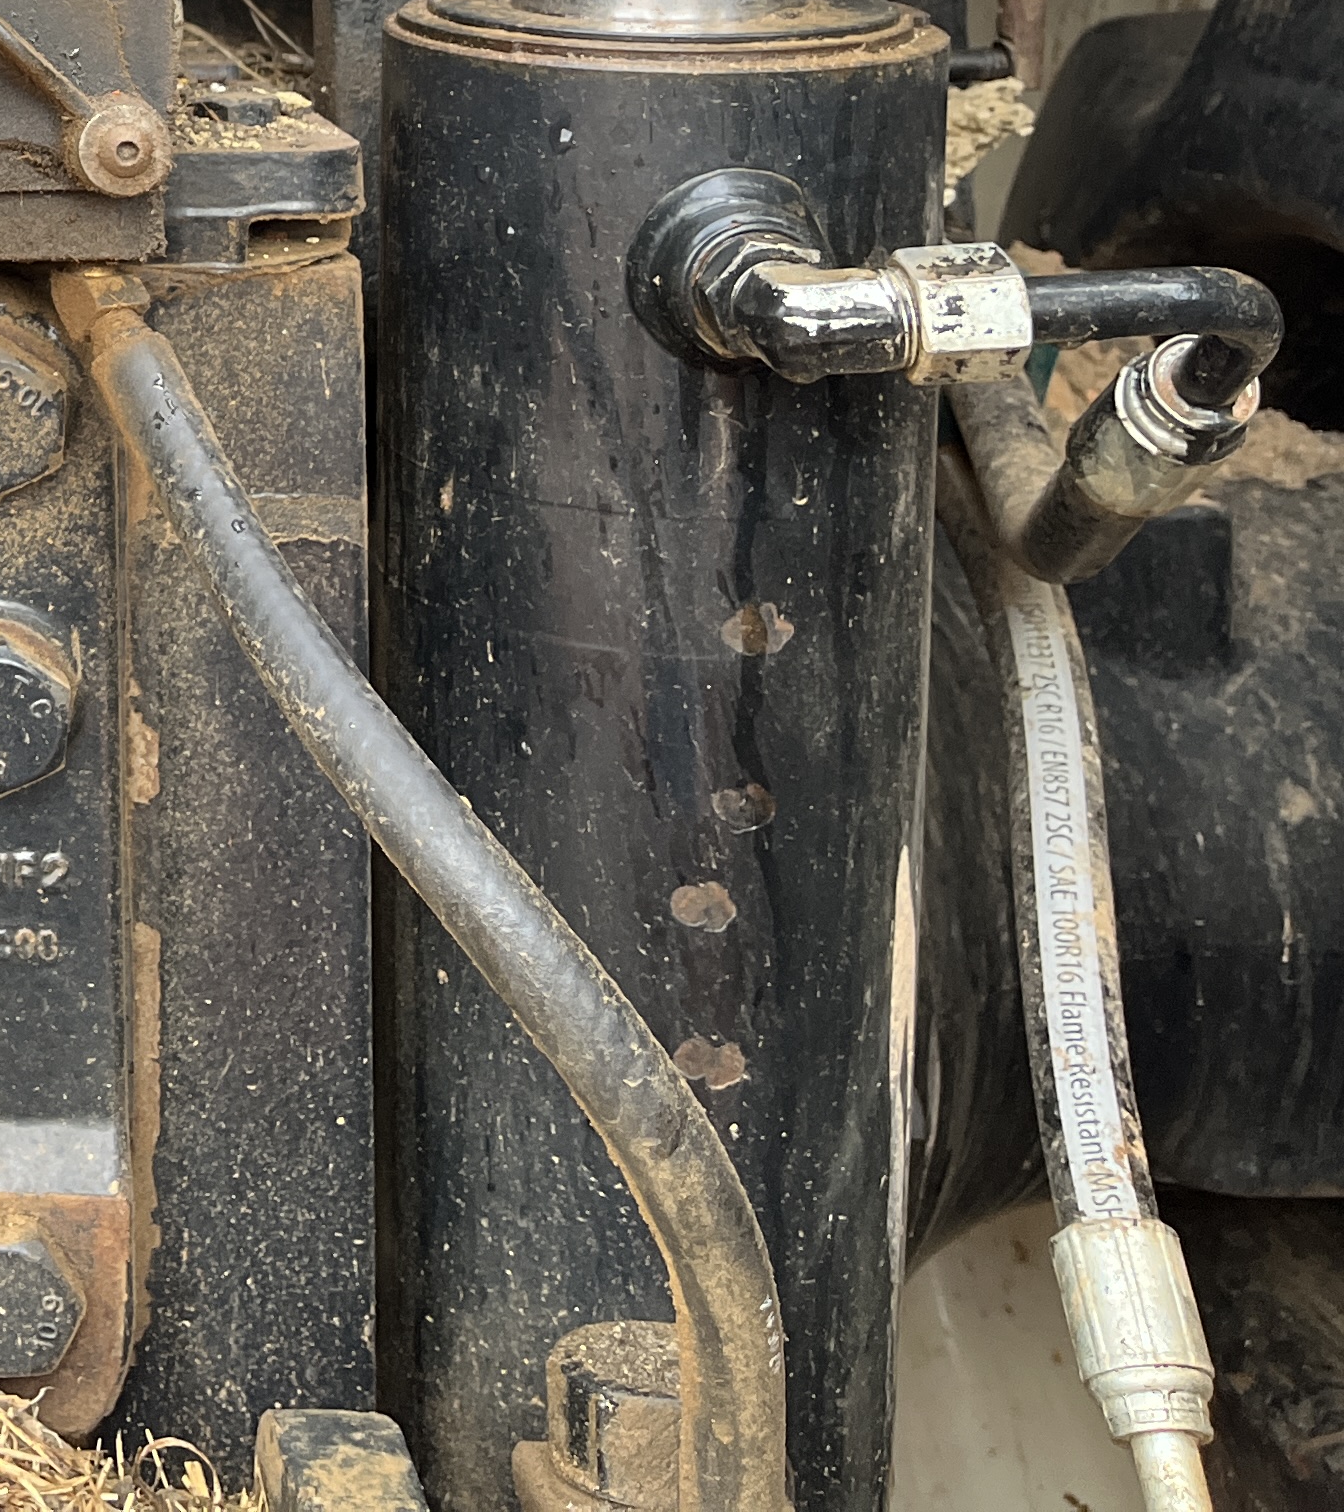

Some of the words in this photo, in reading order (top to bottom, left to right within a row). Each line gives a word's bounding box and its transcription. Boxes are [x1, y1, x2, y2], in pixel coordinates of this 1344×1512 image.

[1035, 704, 1064, 735] R16
[1040, 750, 1070, 808] EN857
[1045, 811, 1075, 847] 2SC
[1048, 863, 1078, 901] SAE
[1051, 900, 1085, 985] 100R16
[1058, 991, 1088, 1057] Flame
[1068, 1062, 1109, 1167] Resistant
